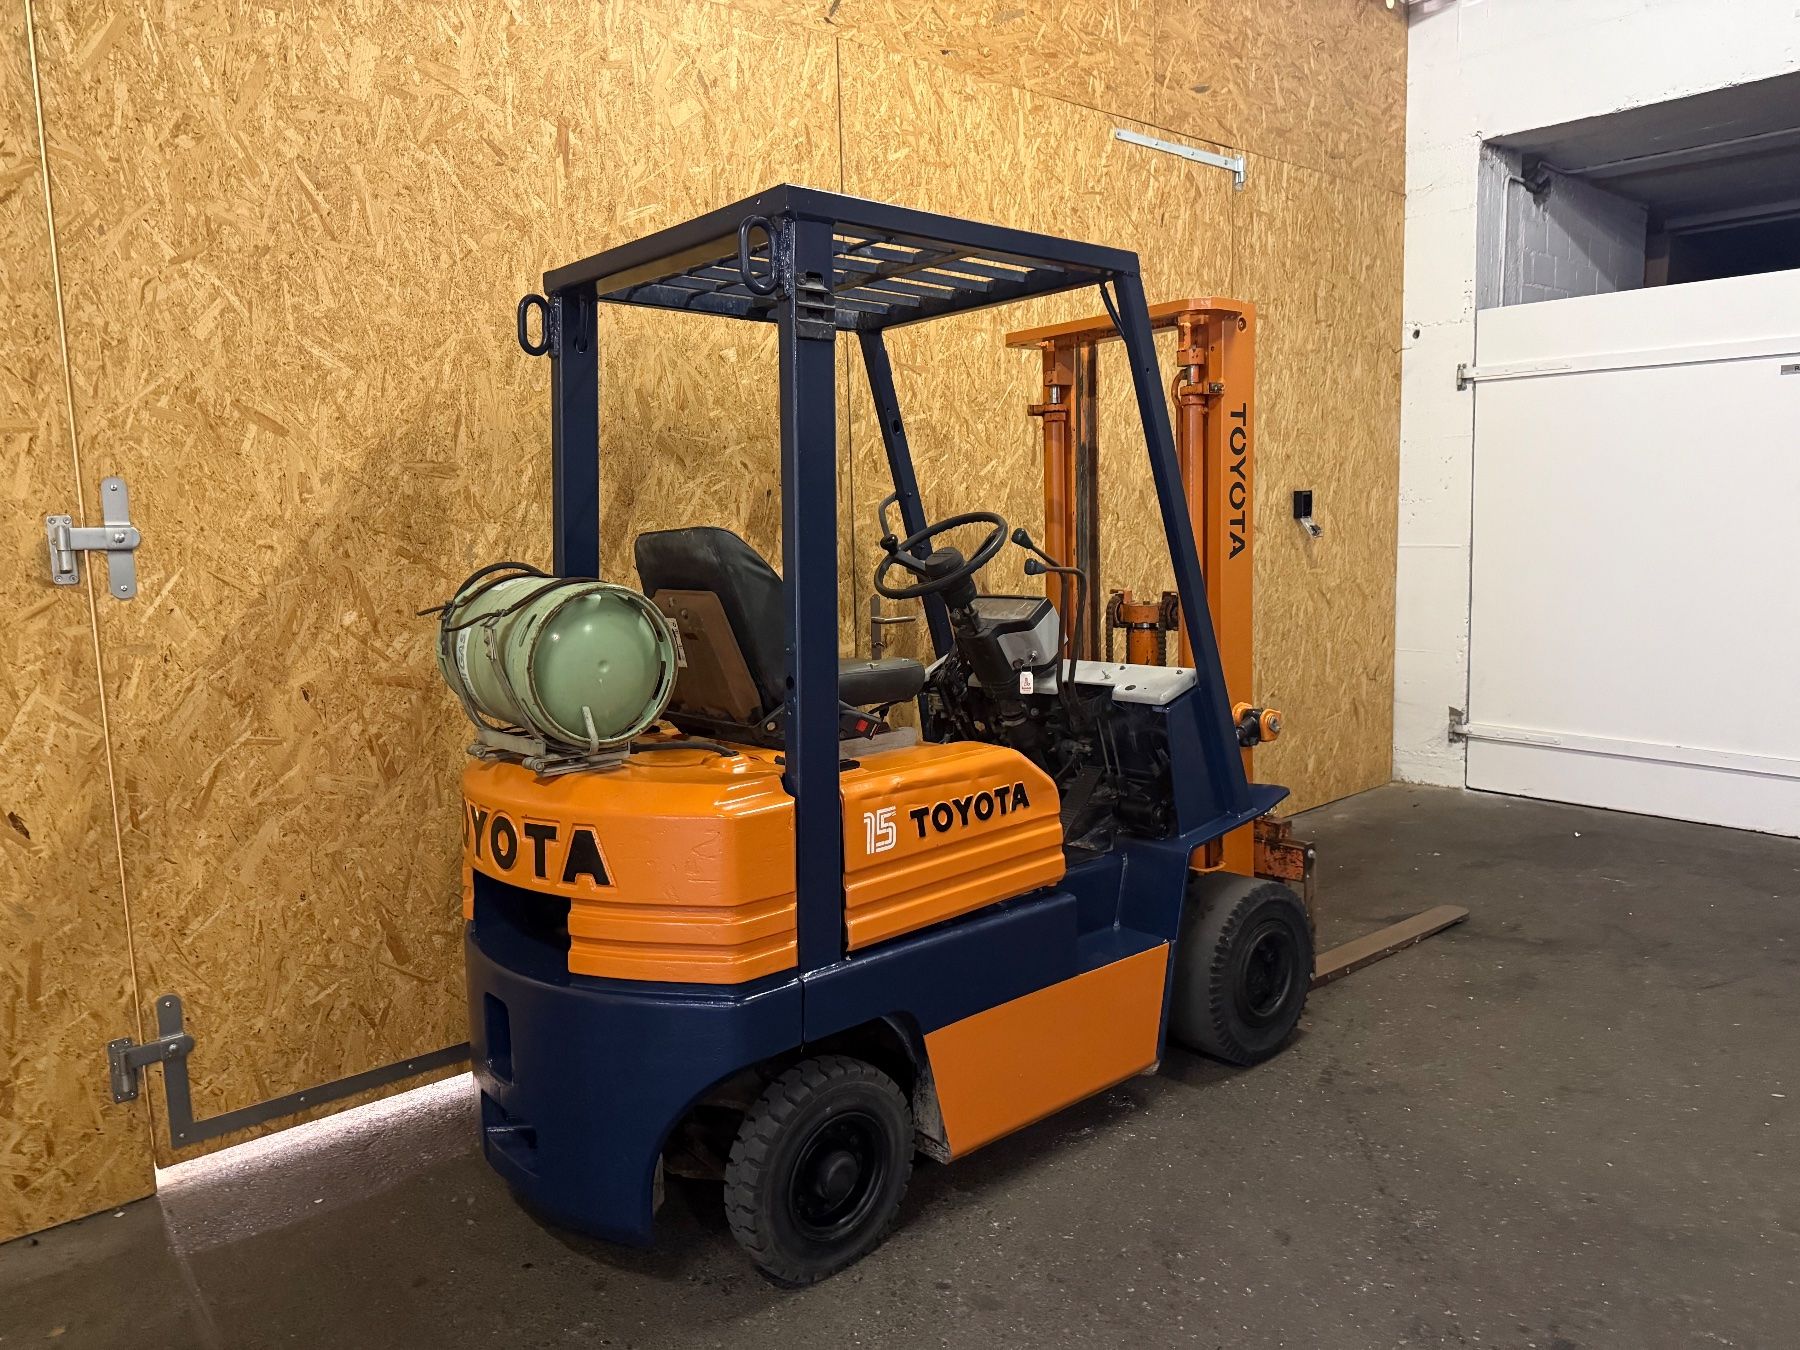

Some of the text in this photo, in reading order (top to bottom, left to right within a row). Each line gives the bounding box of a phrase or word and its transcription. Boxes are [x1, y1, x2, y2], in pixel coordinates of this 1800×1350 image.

[1229, 403, 1247, 560] TOYOTA
[864, 782, 1030, 854] 15 TOYOTA
